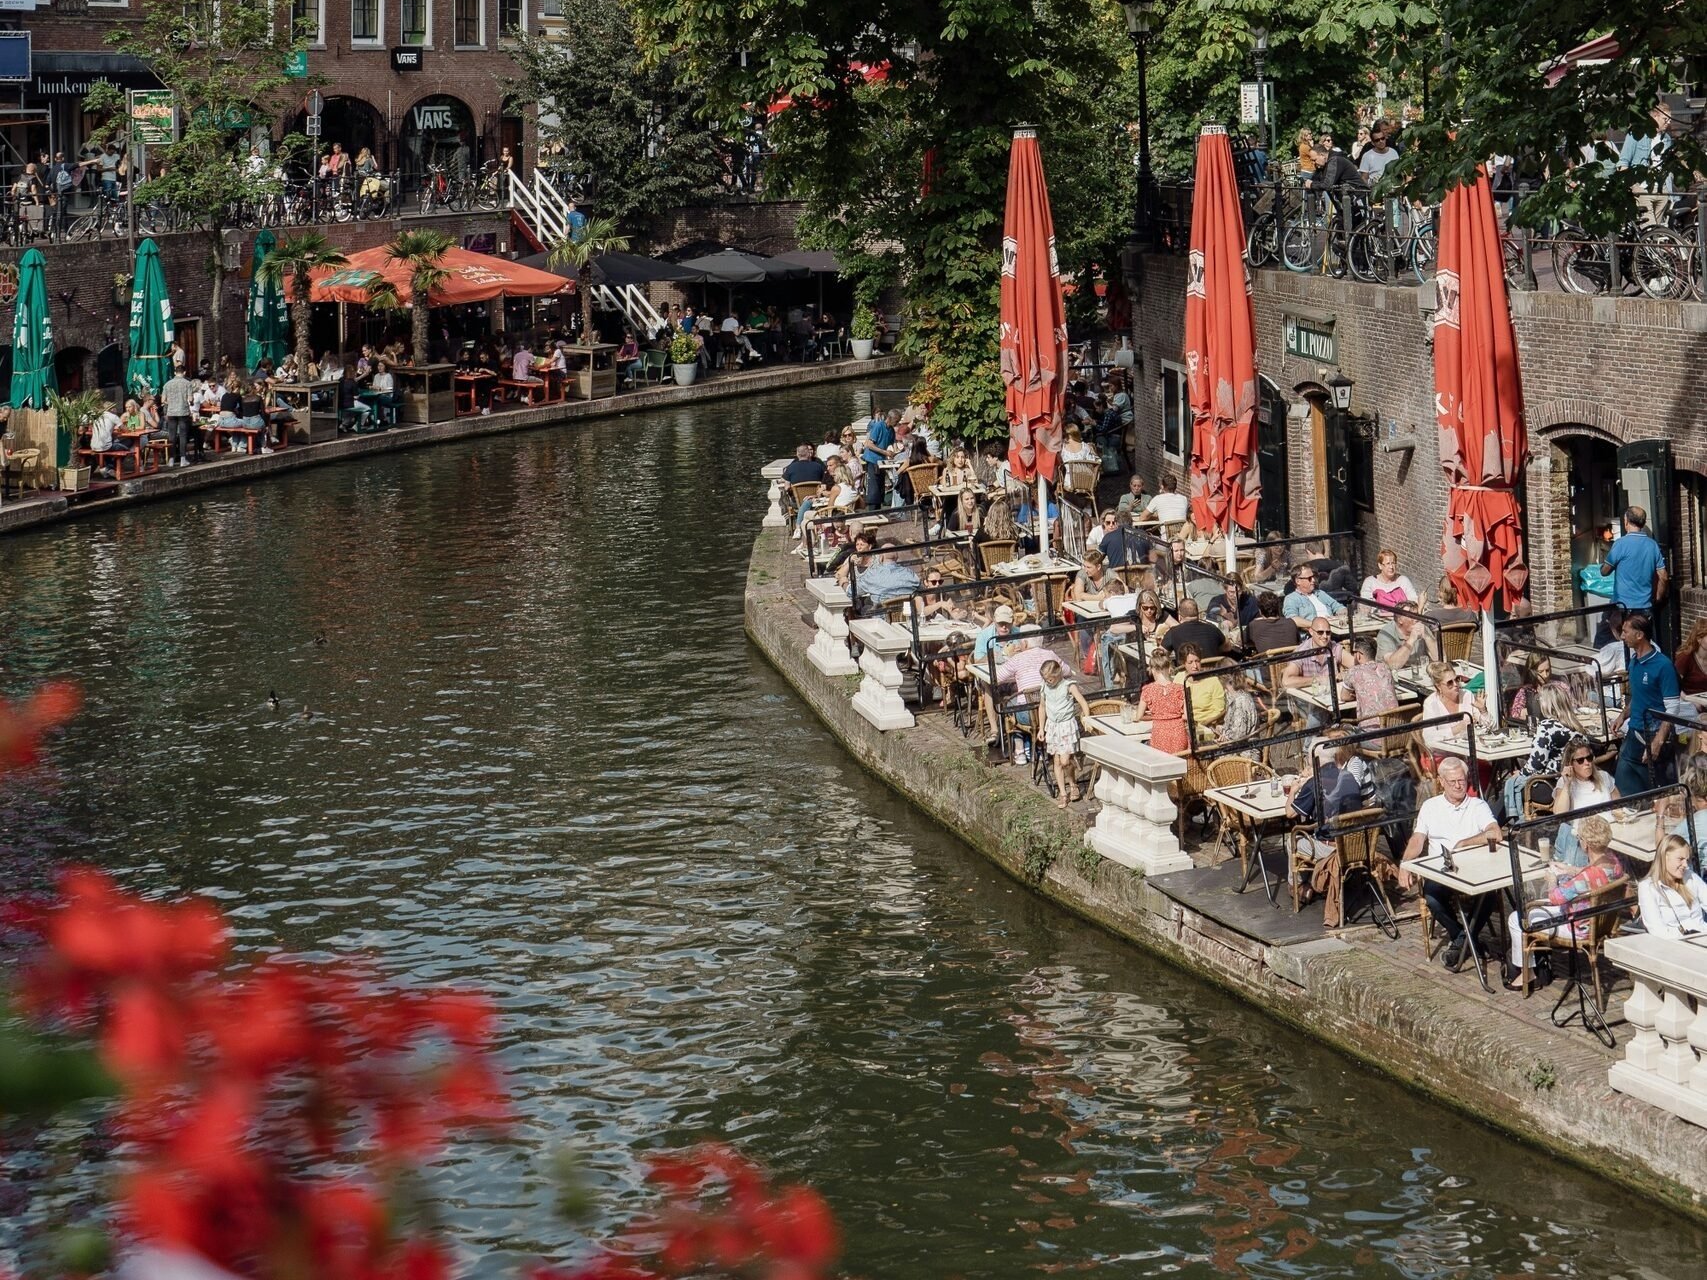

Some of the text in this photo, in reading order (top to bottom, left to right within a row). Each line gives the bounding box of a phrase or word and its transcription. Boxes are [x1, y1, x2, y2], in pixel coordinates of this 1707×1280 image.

[396, 53, 417, 64] VANS
[413, 105, 453, 130] VANS
[1301, 330, 1333, 360] IL POZZO
